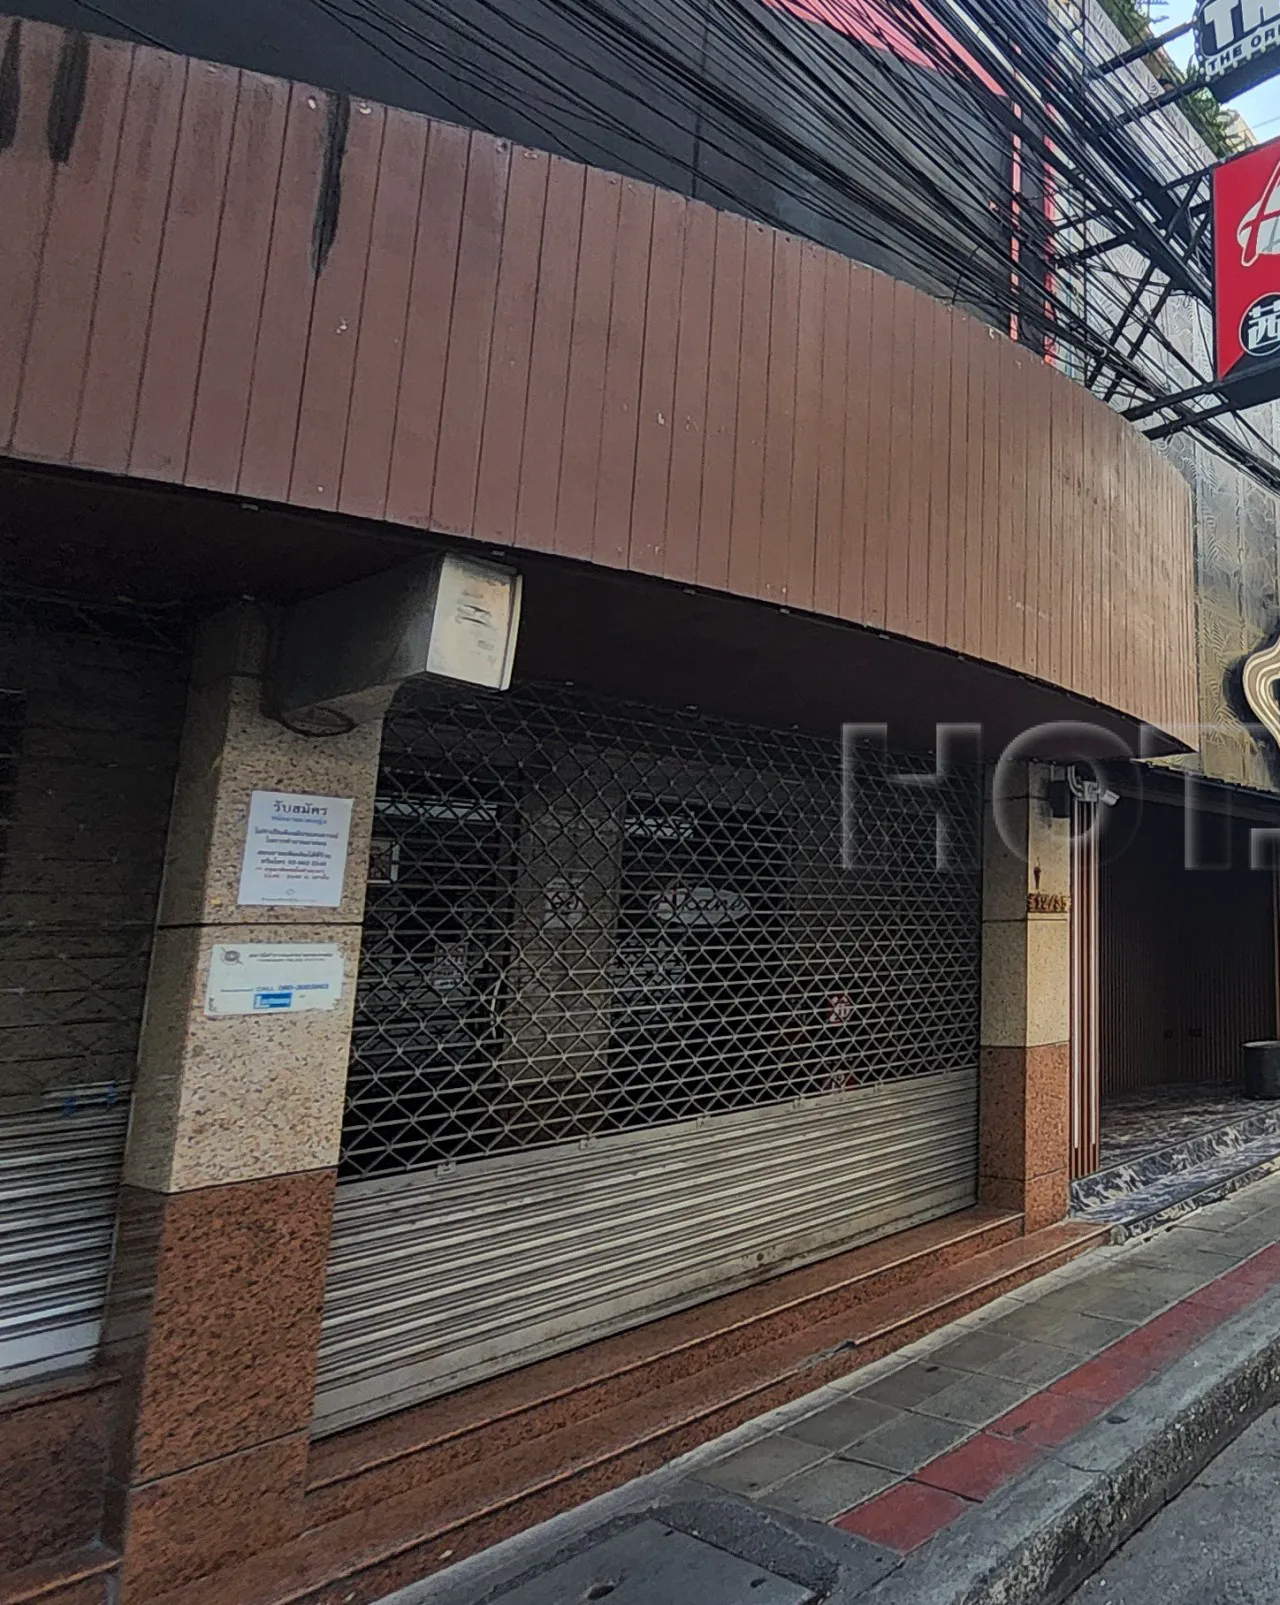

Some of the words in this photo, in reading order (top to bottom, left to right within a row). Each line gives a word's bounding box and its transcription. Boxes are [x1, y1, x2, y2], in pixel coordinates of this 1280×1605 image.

[1208, 44, 1242, 72] THE
[273, 801, 329, 816] รับสมัคร
